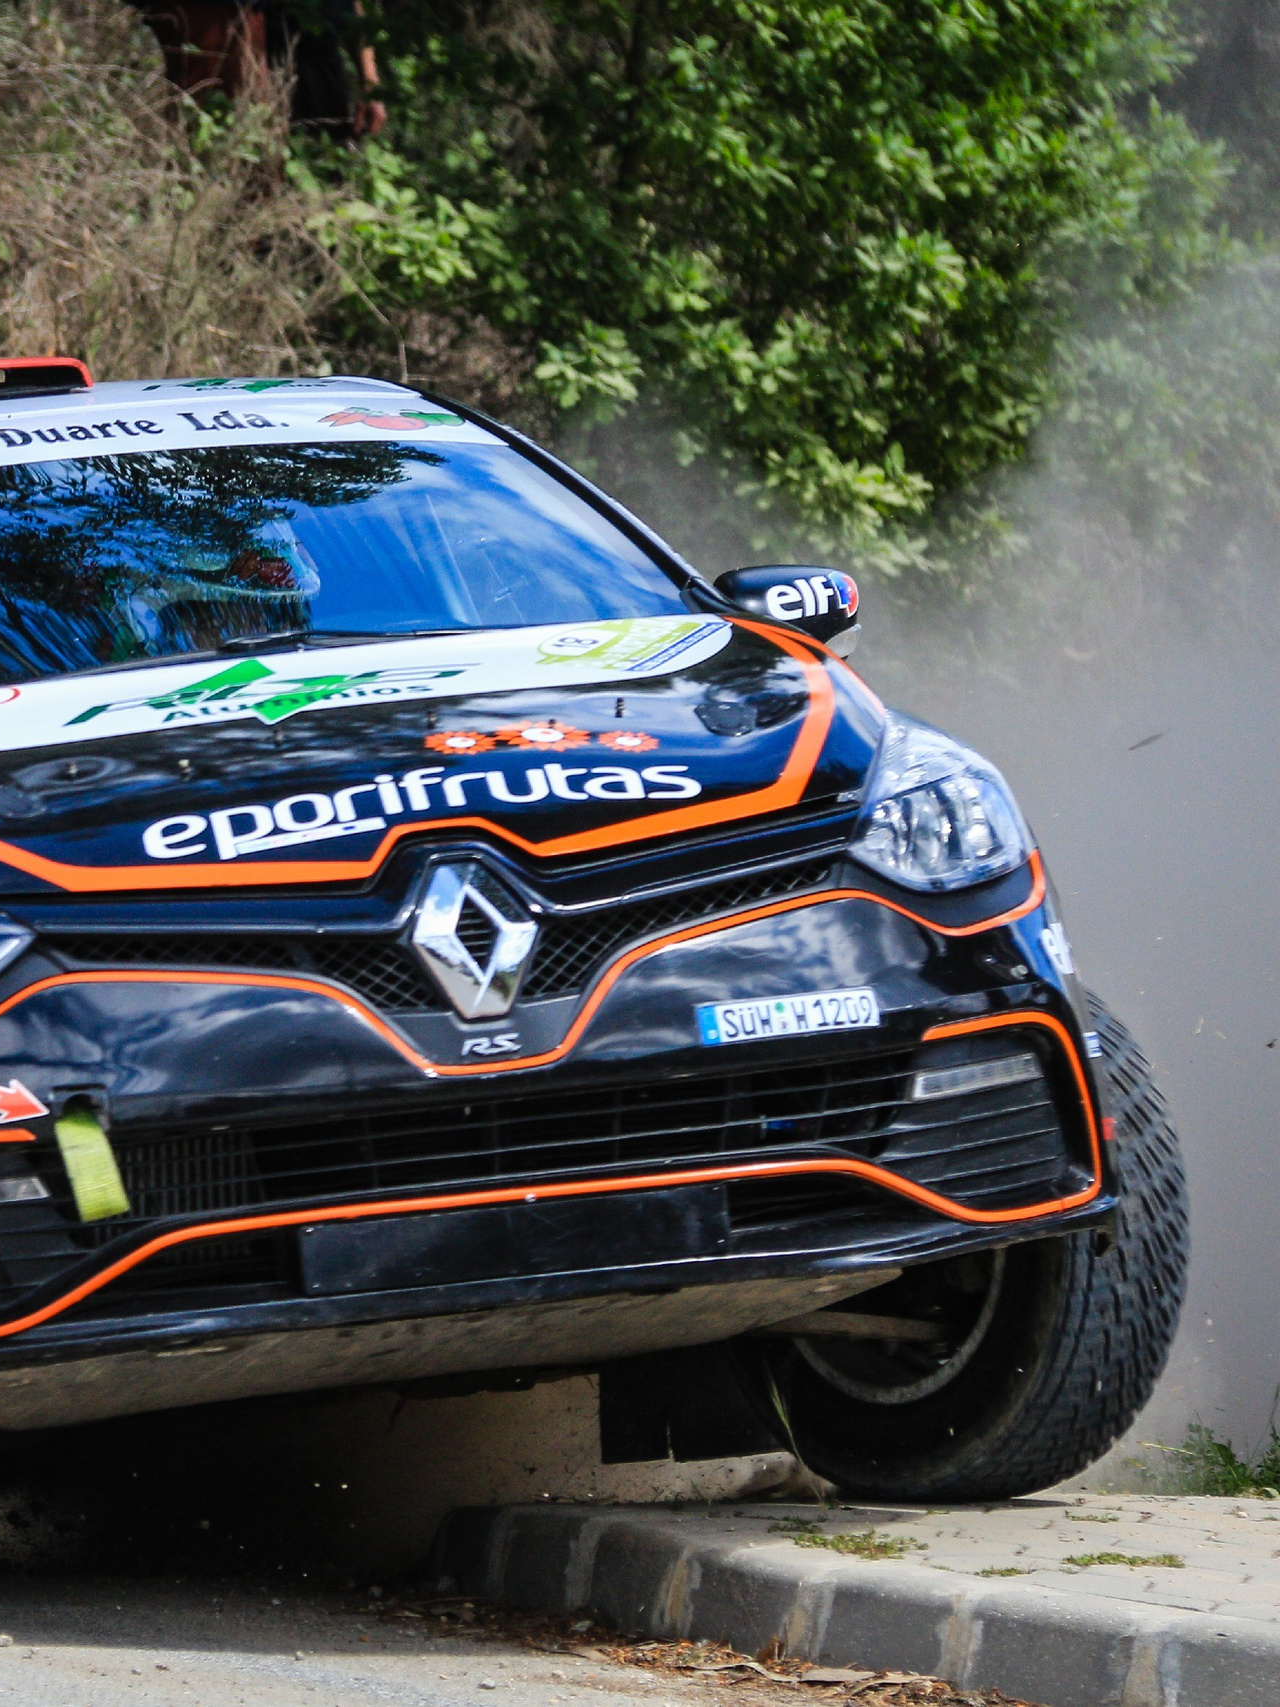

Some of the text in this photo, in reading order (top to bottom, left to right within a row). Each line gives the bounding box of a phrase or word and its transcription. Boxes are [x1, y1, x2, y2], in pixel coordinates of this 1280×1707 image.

[177, 410, 289, 431] Lda.
[767, 575, 834, 621] elf
[142, 762, 703, 860] eporifrutas
[812, 995, 873, 1027] 1209
[461, 1032, 523, 1057] RS
